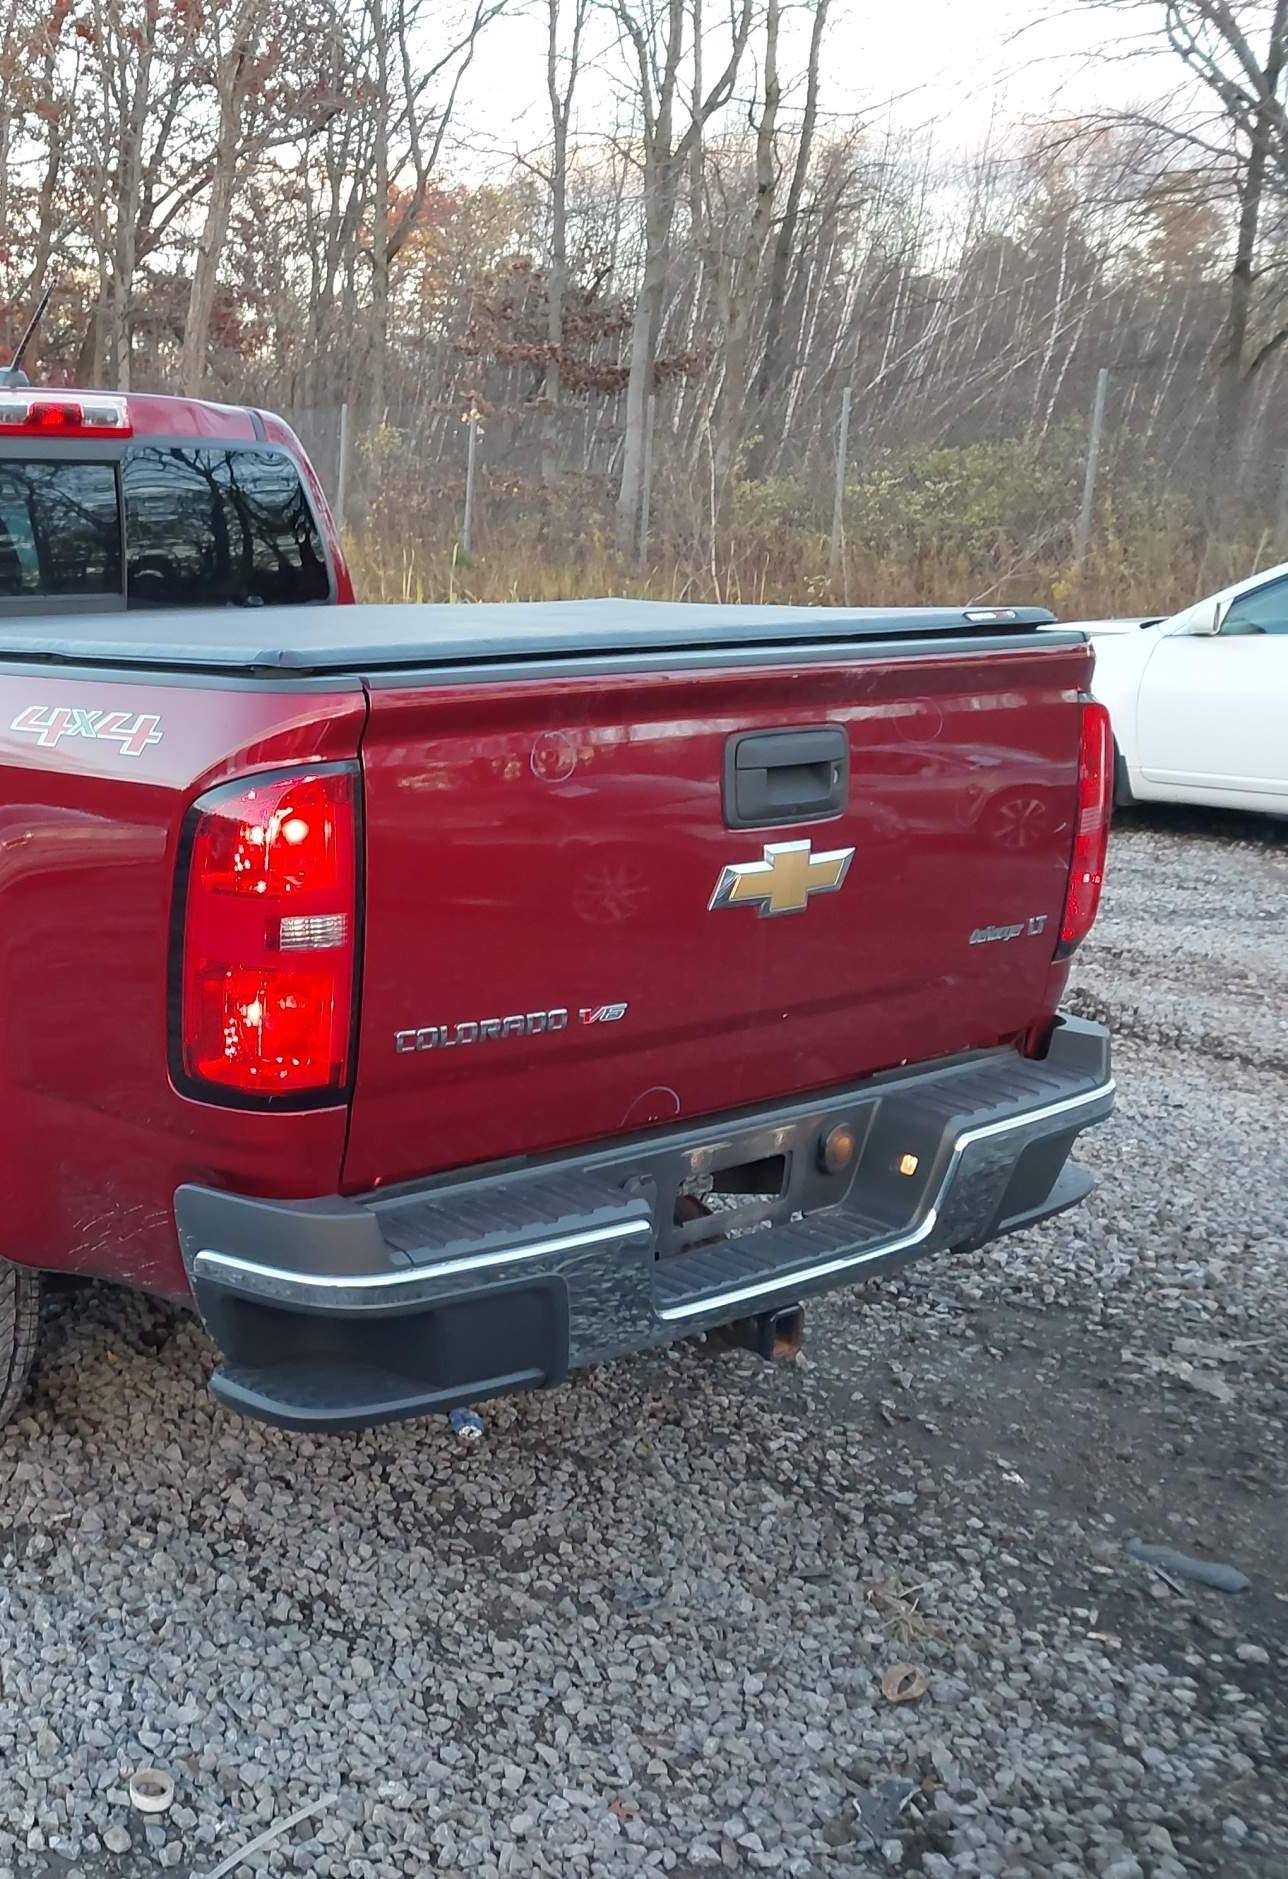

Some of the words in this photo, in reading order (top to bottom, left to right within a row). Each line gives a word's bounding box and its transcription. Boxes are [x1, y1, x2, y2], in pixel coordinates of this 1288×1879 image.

[1027, 914, 1048, 936] LT
[394, 1008, 568, 1054] COLORADO
[579, 1002, 628, 1025] V6
